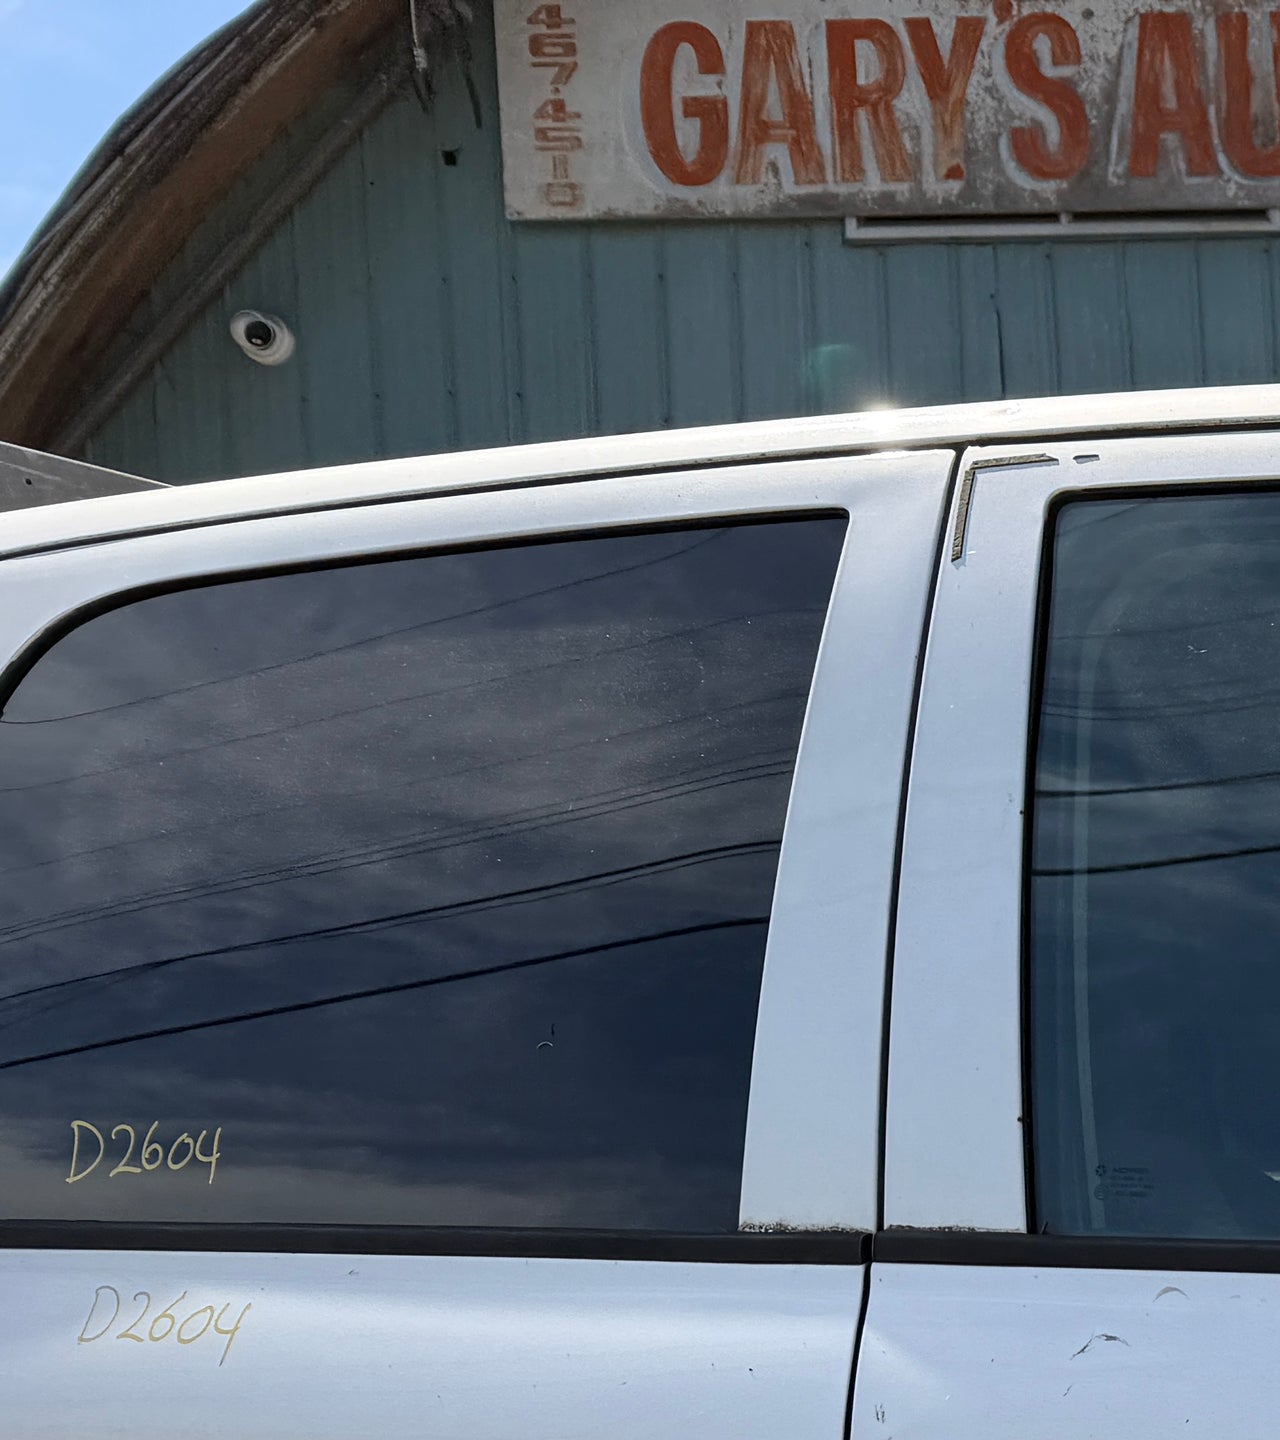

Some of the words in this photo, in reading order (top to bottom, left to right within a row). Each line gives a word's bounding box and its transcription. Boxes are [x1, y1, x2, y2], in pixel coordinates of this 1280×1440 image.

[640, 0, 1090, 186] GARY'S
[65, 1120, 222, 1184] D2604
[77, 1285, 252, 1367] D2604
